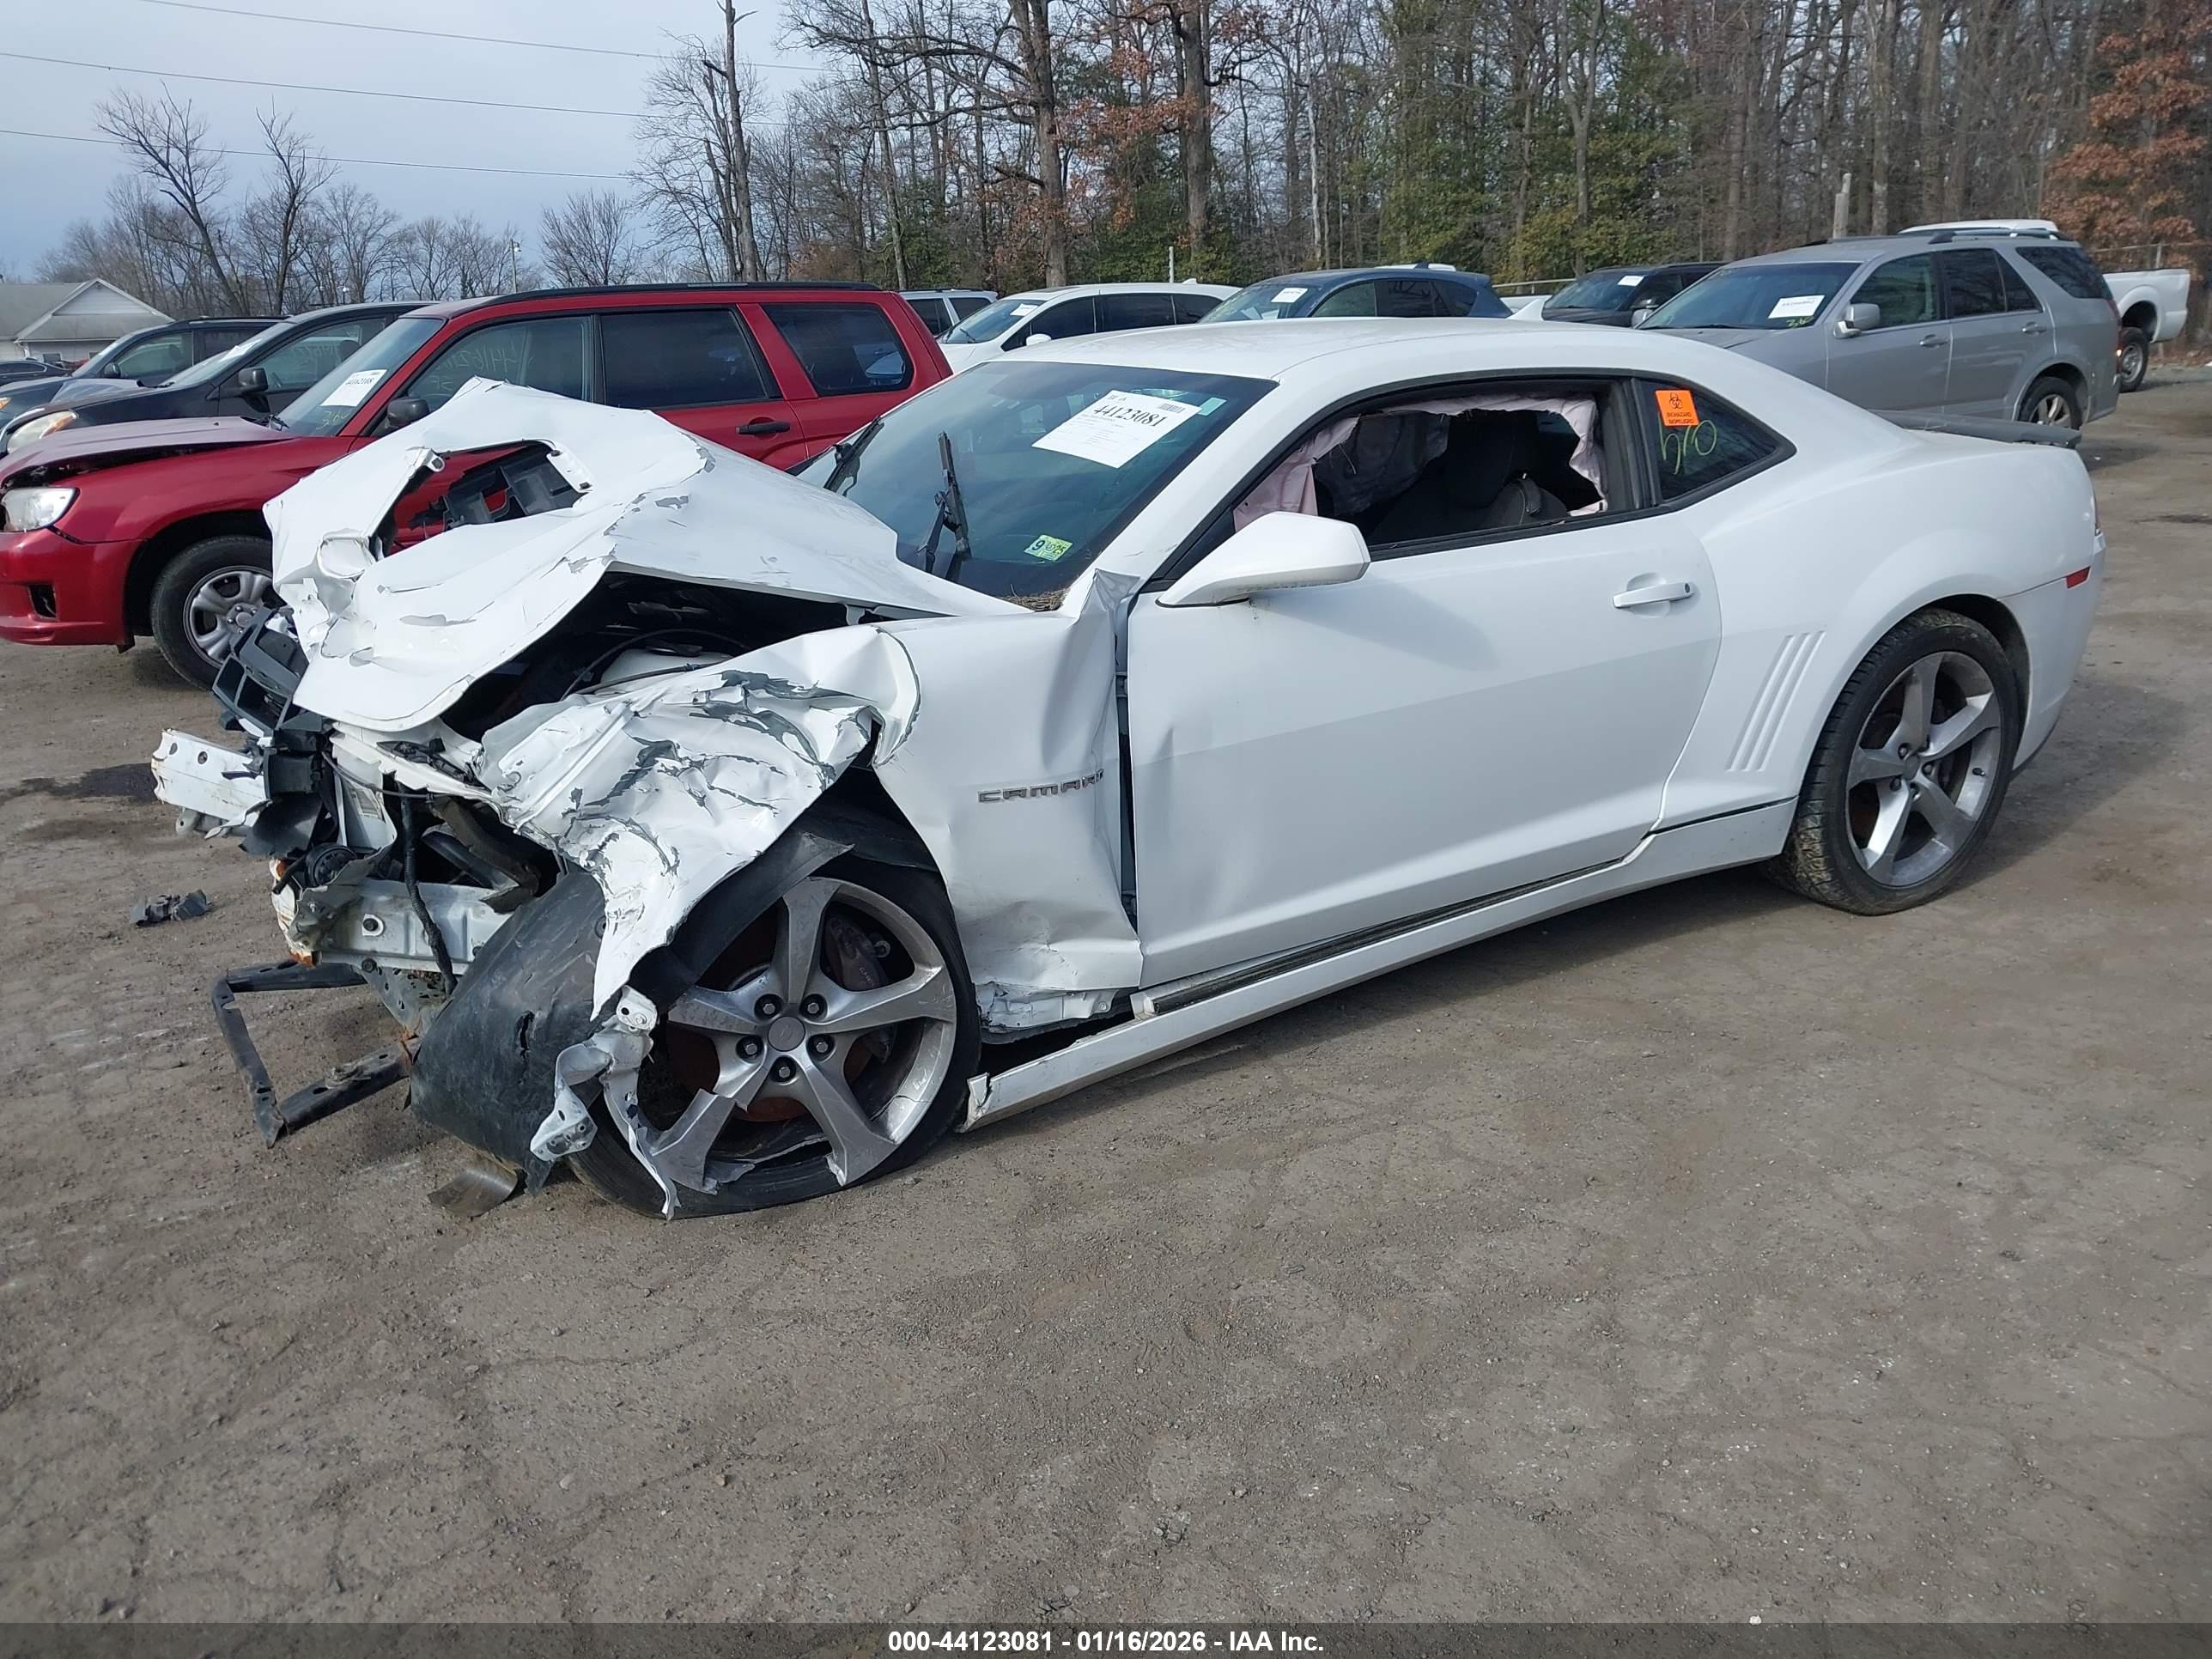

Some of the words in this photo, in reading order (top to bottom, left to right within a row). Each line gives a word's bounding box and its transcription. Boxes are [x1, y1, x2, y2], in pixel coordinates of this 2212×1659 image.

[1093, 404, 1168, 426] 44123081
[1031, 540, 1046, 551] 9
[1052, 544, 1067, 555] 25
